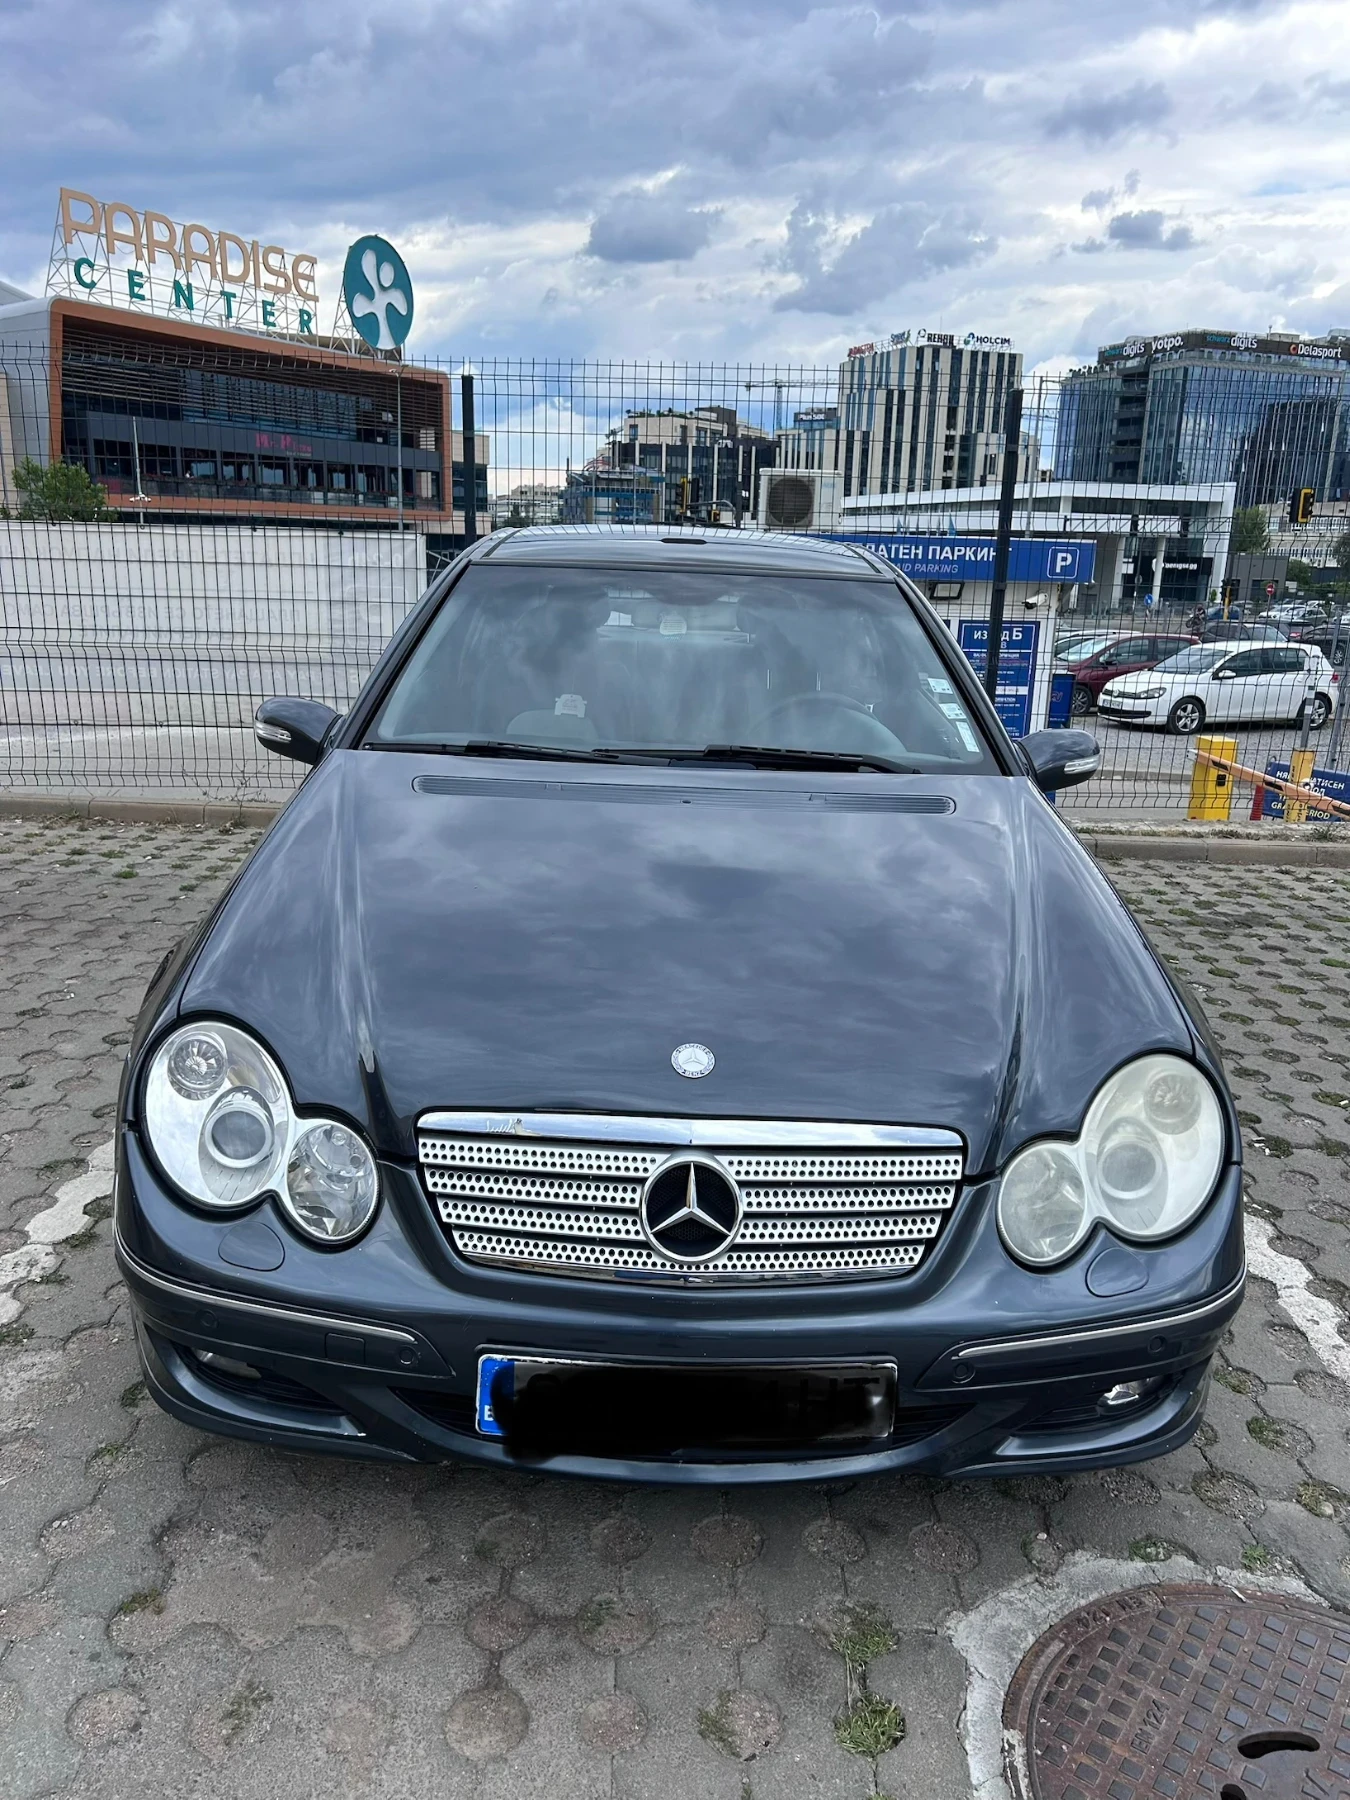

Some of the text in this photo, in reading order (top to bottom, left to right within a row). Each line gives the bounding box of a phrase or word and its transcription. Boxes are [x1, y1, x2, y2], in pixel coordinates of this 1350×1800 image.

[60, 187, 319, 303] PARADISE
[73, 257, 313, 335] CENTER
[976, 336, 1011, 345] HOLCIM
[1151, 336, 1184, 353] yotpo.
[1231, 333, 1258, 350] digits
[1123, 341, 1145, 357] digits
[1298, 344, 1342, 359] Delasport
[856, 543, 923, 559] ЛАТЕН
[914, 563, 959, 574] PARKING
[1055, 552, 1073, 574] P
[1012, 628, 1023, 640] Б
[1143, 1699, 1171, 1731] 124
